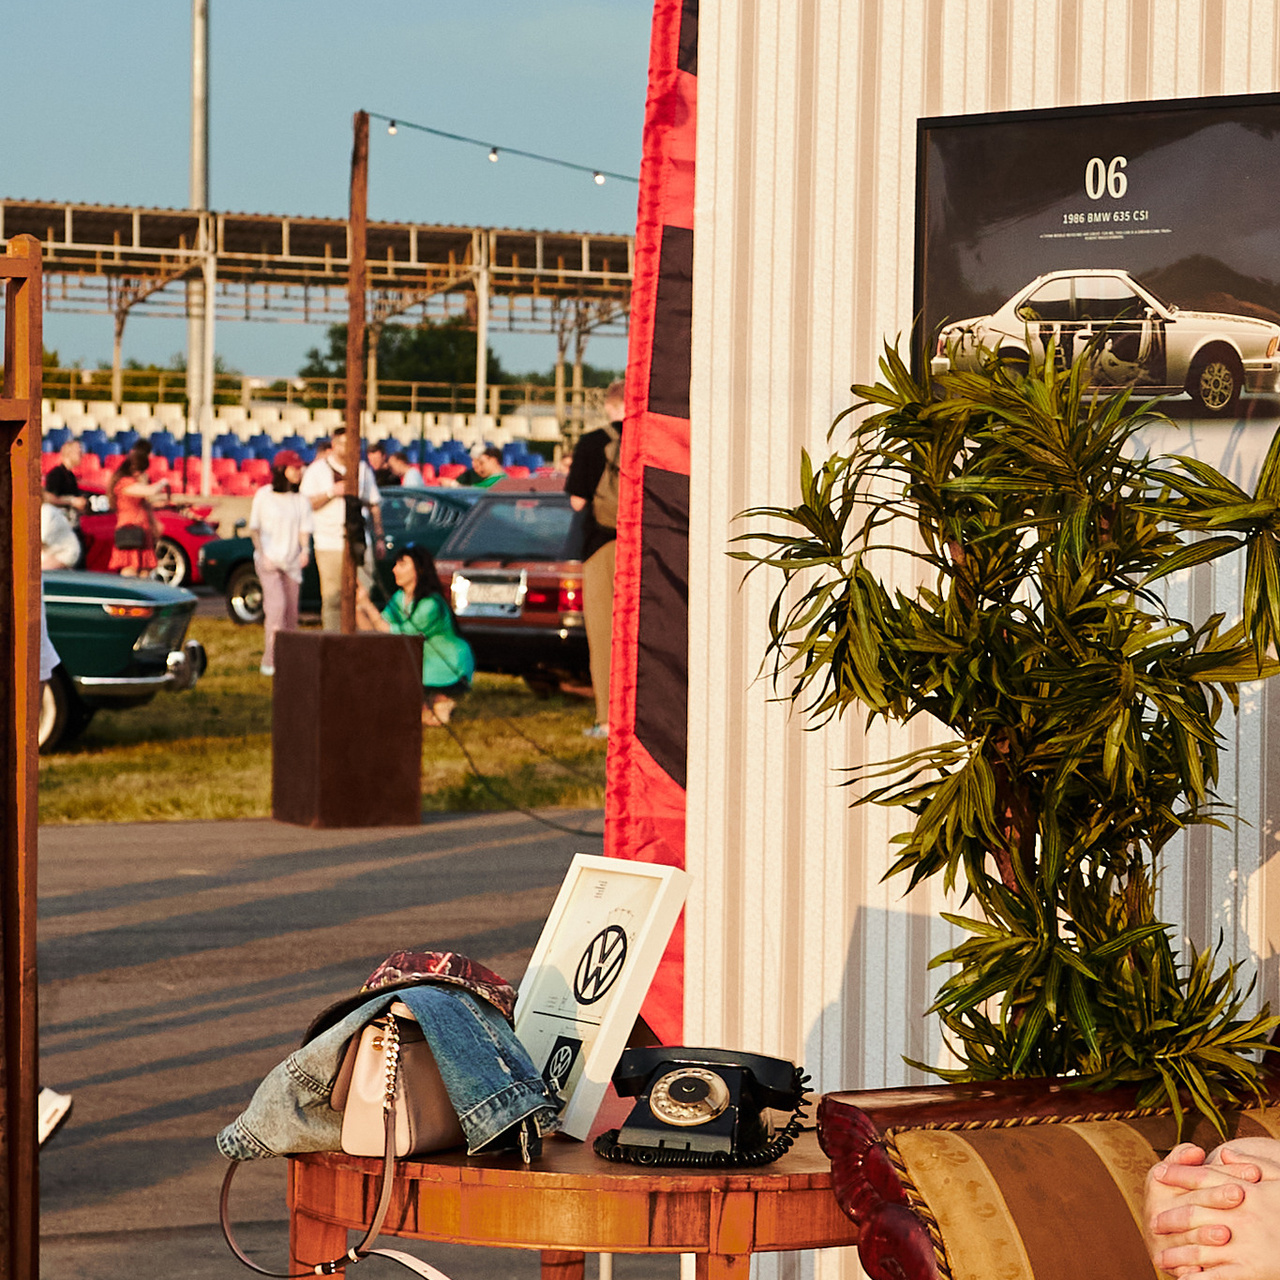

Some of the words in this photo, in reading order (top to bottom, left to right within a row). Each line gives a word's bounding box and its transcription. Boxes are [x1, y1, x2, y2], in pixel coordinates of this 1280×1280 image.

[1085, 156, 1128, 200] 06
[1063, 213, 1085, 224] 1986
[1087, 212, 1112, 223] BMW
[1113, 211, 1131, 222] 635
[1133, 210, 1149, 221] CSI
